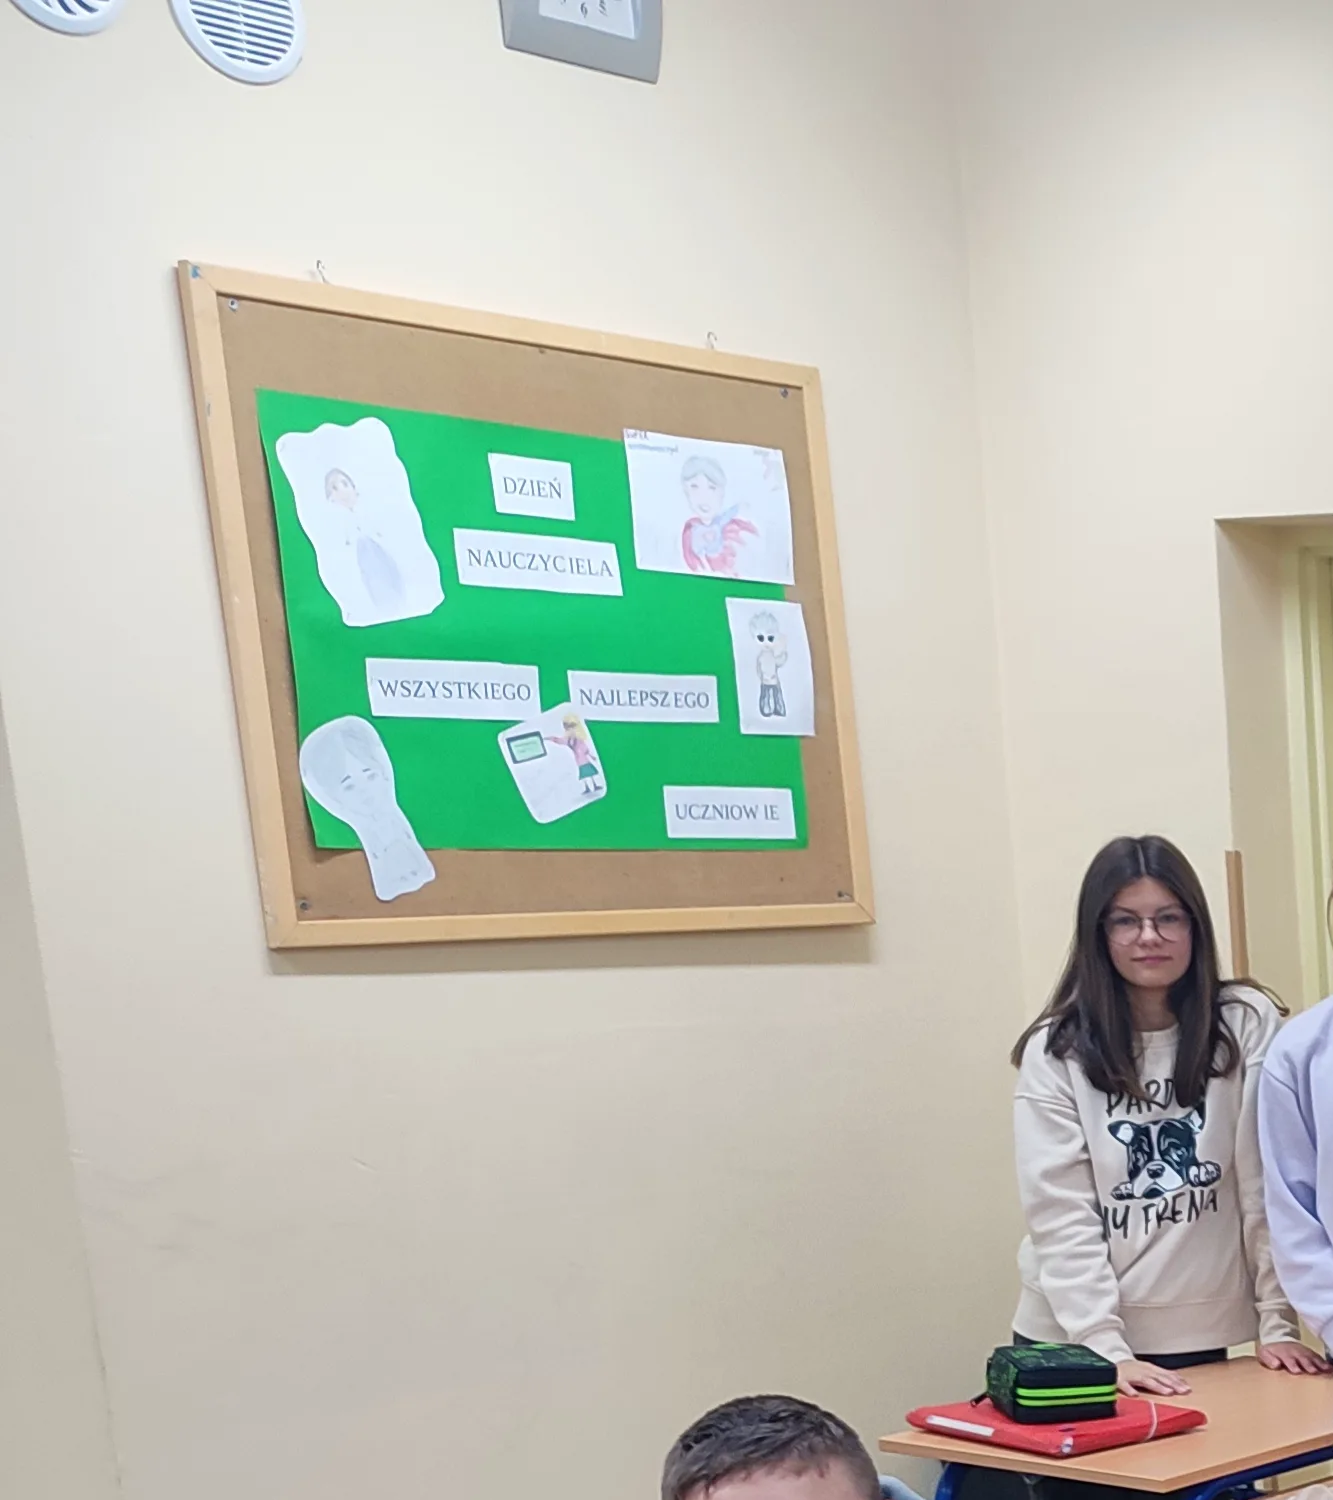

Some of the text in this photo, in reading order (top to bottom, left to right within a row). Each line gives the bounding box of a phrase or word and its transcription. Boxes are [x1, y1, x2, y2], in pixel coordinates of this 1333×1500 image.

[502, 474, 563, 501] DZIEŃ
[466, 548, 614, 579] NAUCZYCIELA
[378, 678, 710, 710] WSZYSTKIEGO NAJLEPSZEGO
